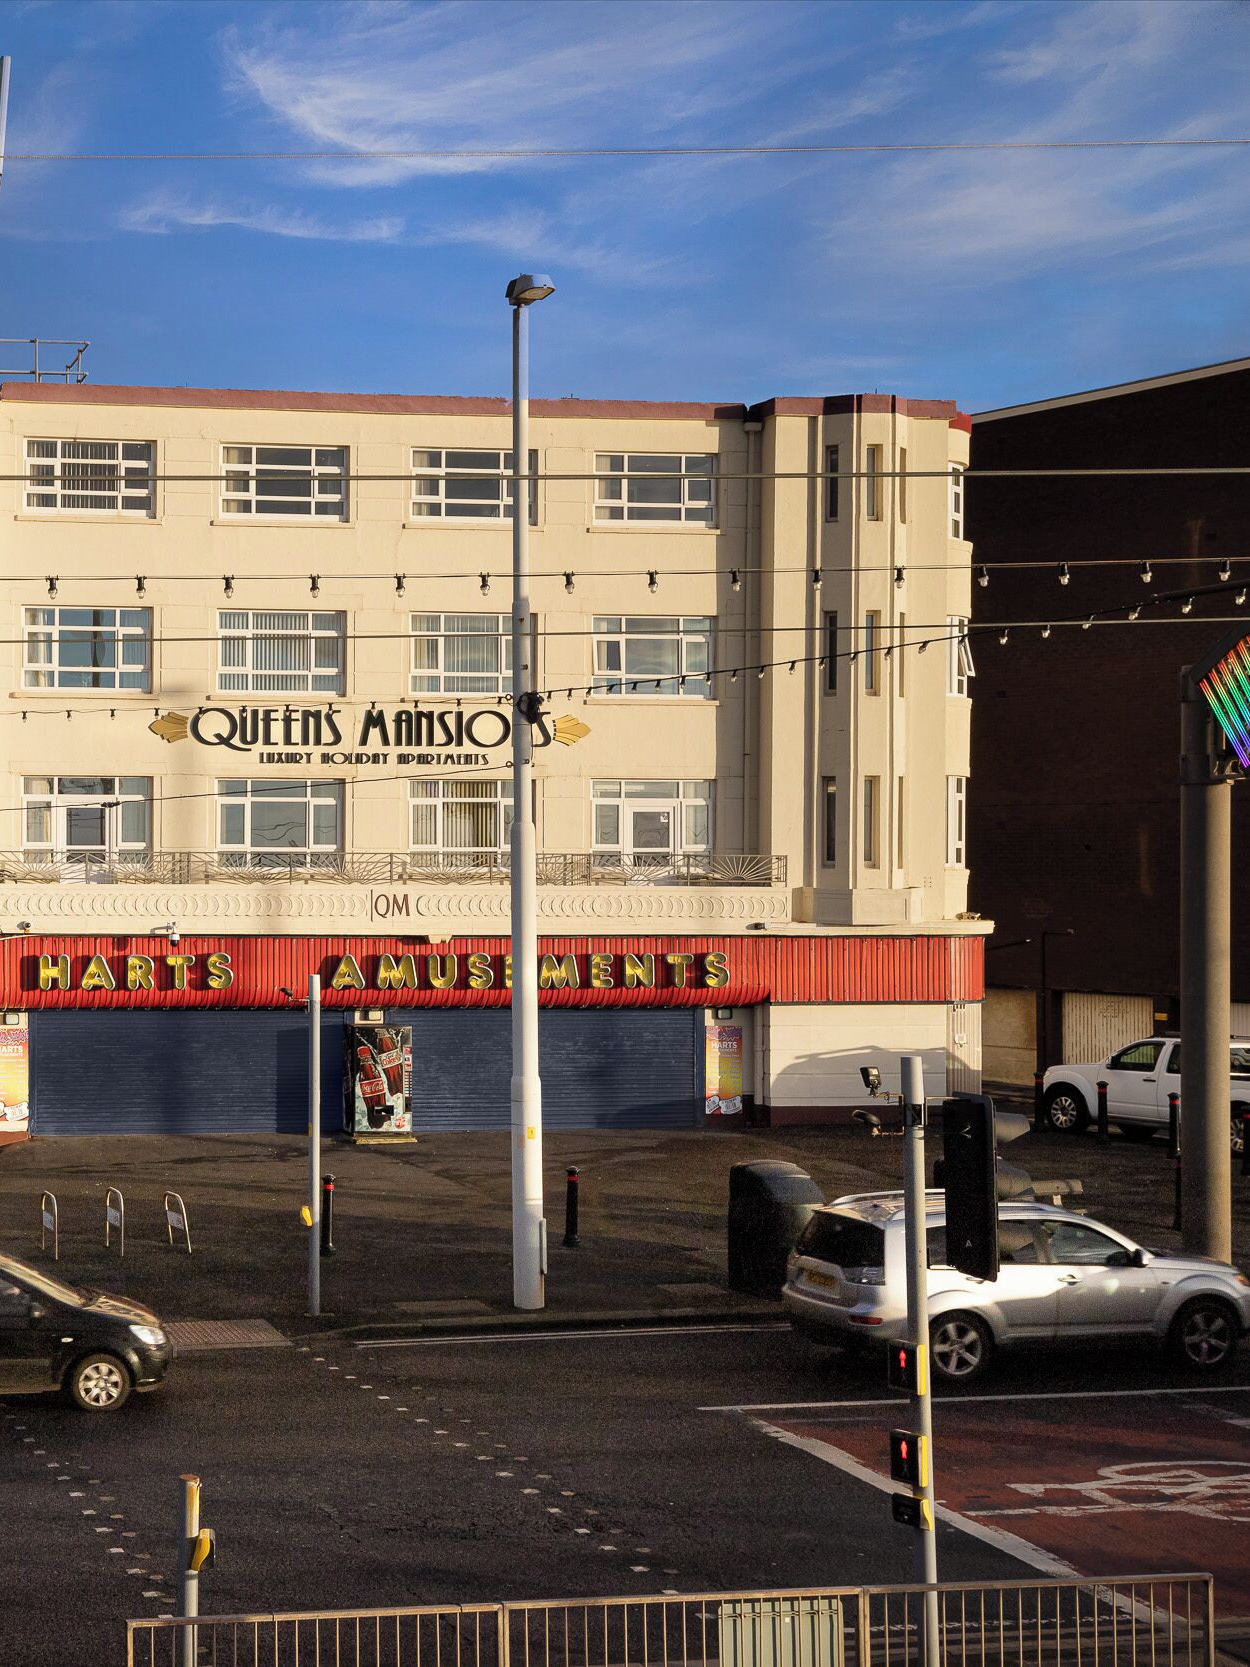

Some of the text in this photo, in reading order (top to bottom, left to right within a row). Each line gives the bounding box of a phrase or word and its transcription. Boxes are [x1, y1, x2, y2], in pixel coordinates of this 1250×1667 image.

[190, 707, 552, 751] QUEENS MANSIOS
[258, 752, 490, 766] LUXURY HOLIDAY APARTMENTS
[374, 893, 411, 919] QM
[38, 952, 235, 991] HARTS
[711, 1041, 738, 1049] HARTS
[965, 1239, 973, 1248] A
